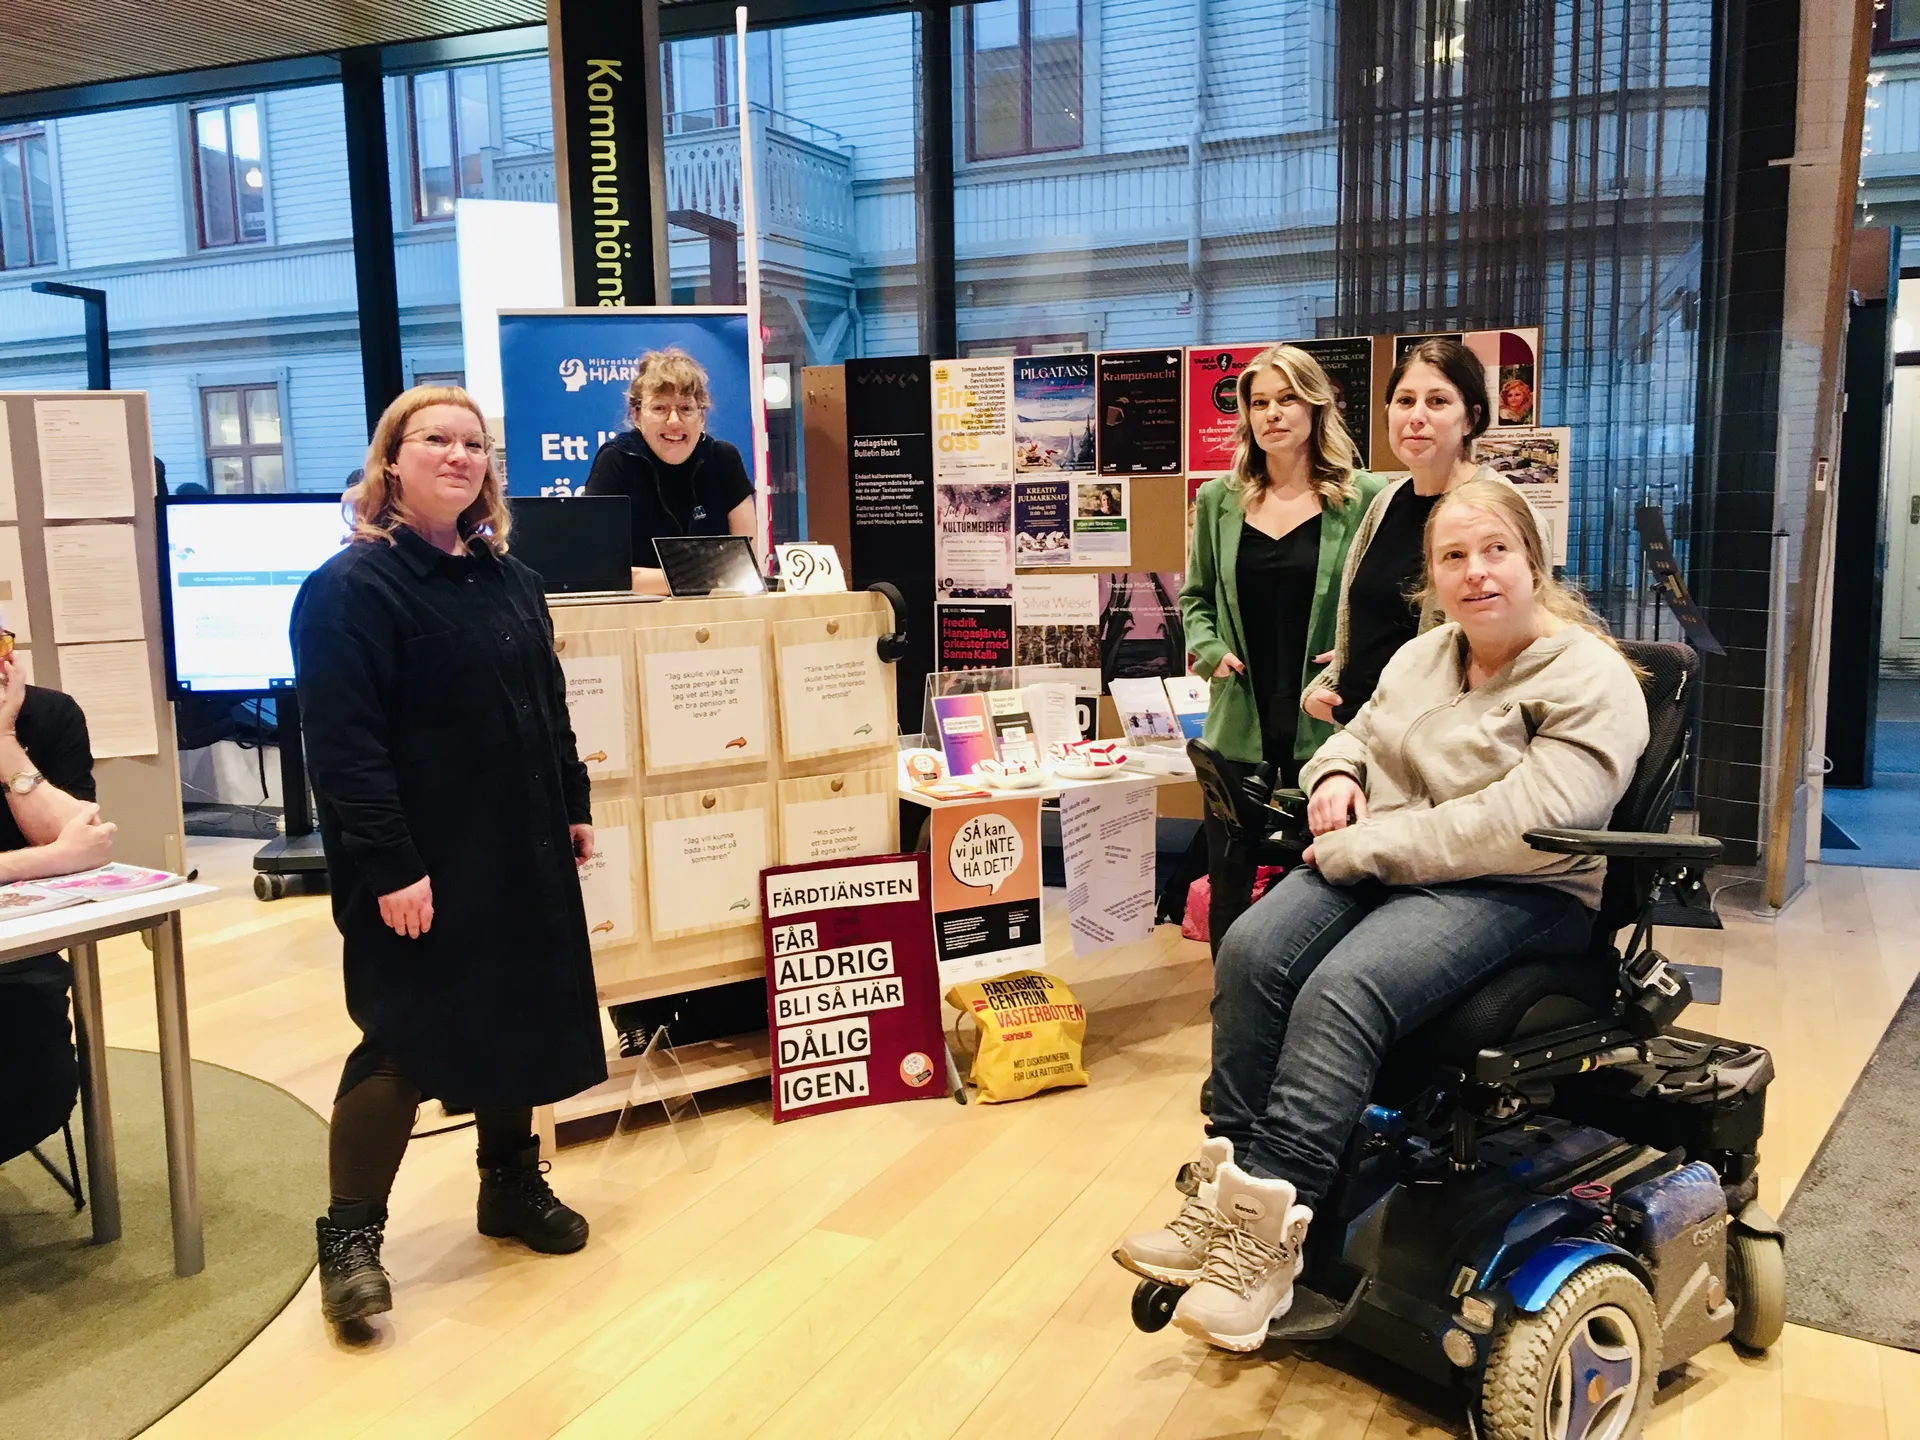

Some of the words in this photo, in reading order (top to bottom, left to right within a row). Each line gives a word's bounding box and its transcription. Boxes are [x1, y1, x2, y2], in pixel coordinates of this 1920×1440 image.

[589, 358, 640, 369] Hjärnskad
[589, 366, 640, 385] HJÄRN
[1020, 365, 1088, 380] PILGATANS
[1103, 369, 1176, 382] Krampusnacht
[541, 433, 588, 461] Ett
[854, 438, 898, 448] Anslagstavla
[938, 435, 979, 452] oss
[855, 449, 879, 457] Bulletin
[881, 448, 900, 457] Board
[1018, 494, 1069, 503] JULMARKNAD
[942, 521, 1006, 533] KULTURMEJERIET
[1053, 597, 1091, 608] Wieser
[943, 618, 977, 628] Fredrik
[943, 628, 1007, 640] Hangasjärvis
[943, 639, 984, 649] orkester
[986, 639, 1009, 649] med
[944, 649, 973, 658] Sanna
[974, 650, 997, 659] Kalla
[683, 670, 703, 679] skulle
[705, 669, 720, 678] vilja
[722, 667, 743, 675] kunna
[804, 675, 822, 683] skulle
[824, 673, 846, 681] behöva
[847, 670, 866, 678] betala
[671, 683, 691, 691] spara
[693, 680, 717, 689] pengar
[719, 677, 727, 686] så
[711, 689, 722, 698] jag
[685, 701, 697, 709] bra
[699, 699, 726, 708] pension
[728, 697, 738, 705] att
[713, 832, 734, 840] kunna
[962, 819, 981, 842] SÅ
[984, 823, 1006, 837] kan
[835, 835, 857, 843] boende
[684, 847, 701, 855] bada
[708, 843, 726, 851] havet
[728, 840, 737, 848] på
[811, 848, 819, 857] på
[956, 845, 966, 858] vi
[970, 842, 982, 860] ju
[985, 836, 1015, 855] INTE
[963, 861, 981, 878] HA
[984, 855, 1014, 876] DET!
[773, 878, 913, 908] FÄRDTJÄNSTEN
[774, 926, 815, 953] FÅR
[779, 947, 889, 985] ALDRIG
[779, 996, 810, 1019] BLI
[818, 985, 847, 1011] SÅ
[853, 982, 901, 1007] HÄR
[988, 990, 1050, 1011] CENTRUM
[994, 1004, 1084, 1028] VÄSTERBOTTEN
[1002, 1030, 1033, 1042] sensus
[780, 1028, 868, 1064] DÅLIG
[1013, 1059, 1026, 1069] MOT
[1026, 1052, 1070, 1067] DISKRIMINERIN
[1026, 1069, 1039, 1079] LIKA
[784, 1069, 865, 1104] IGEN.
